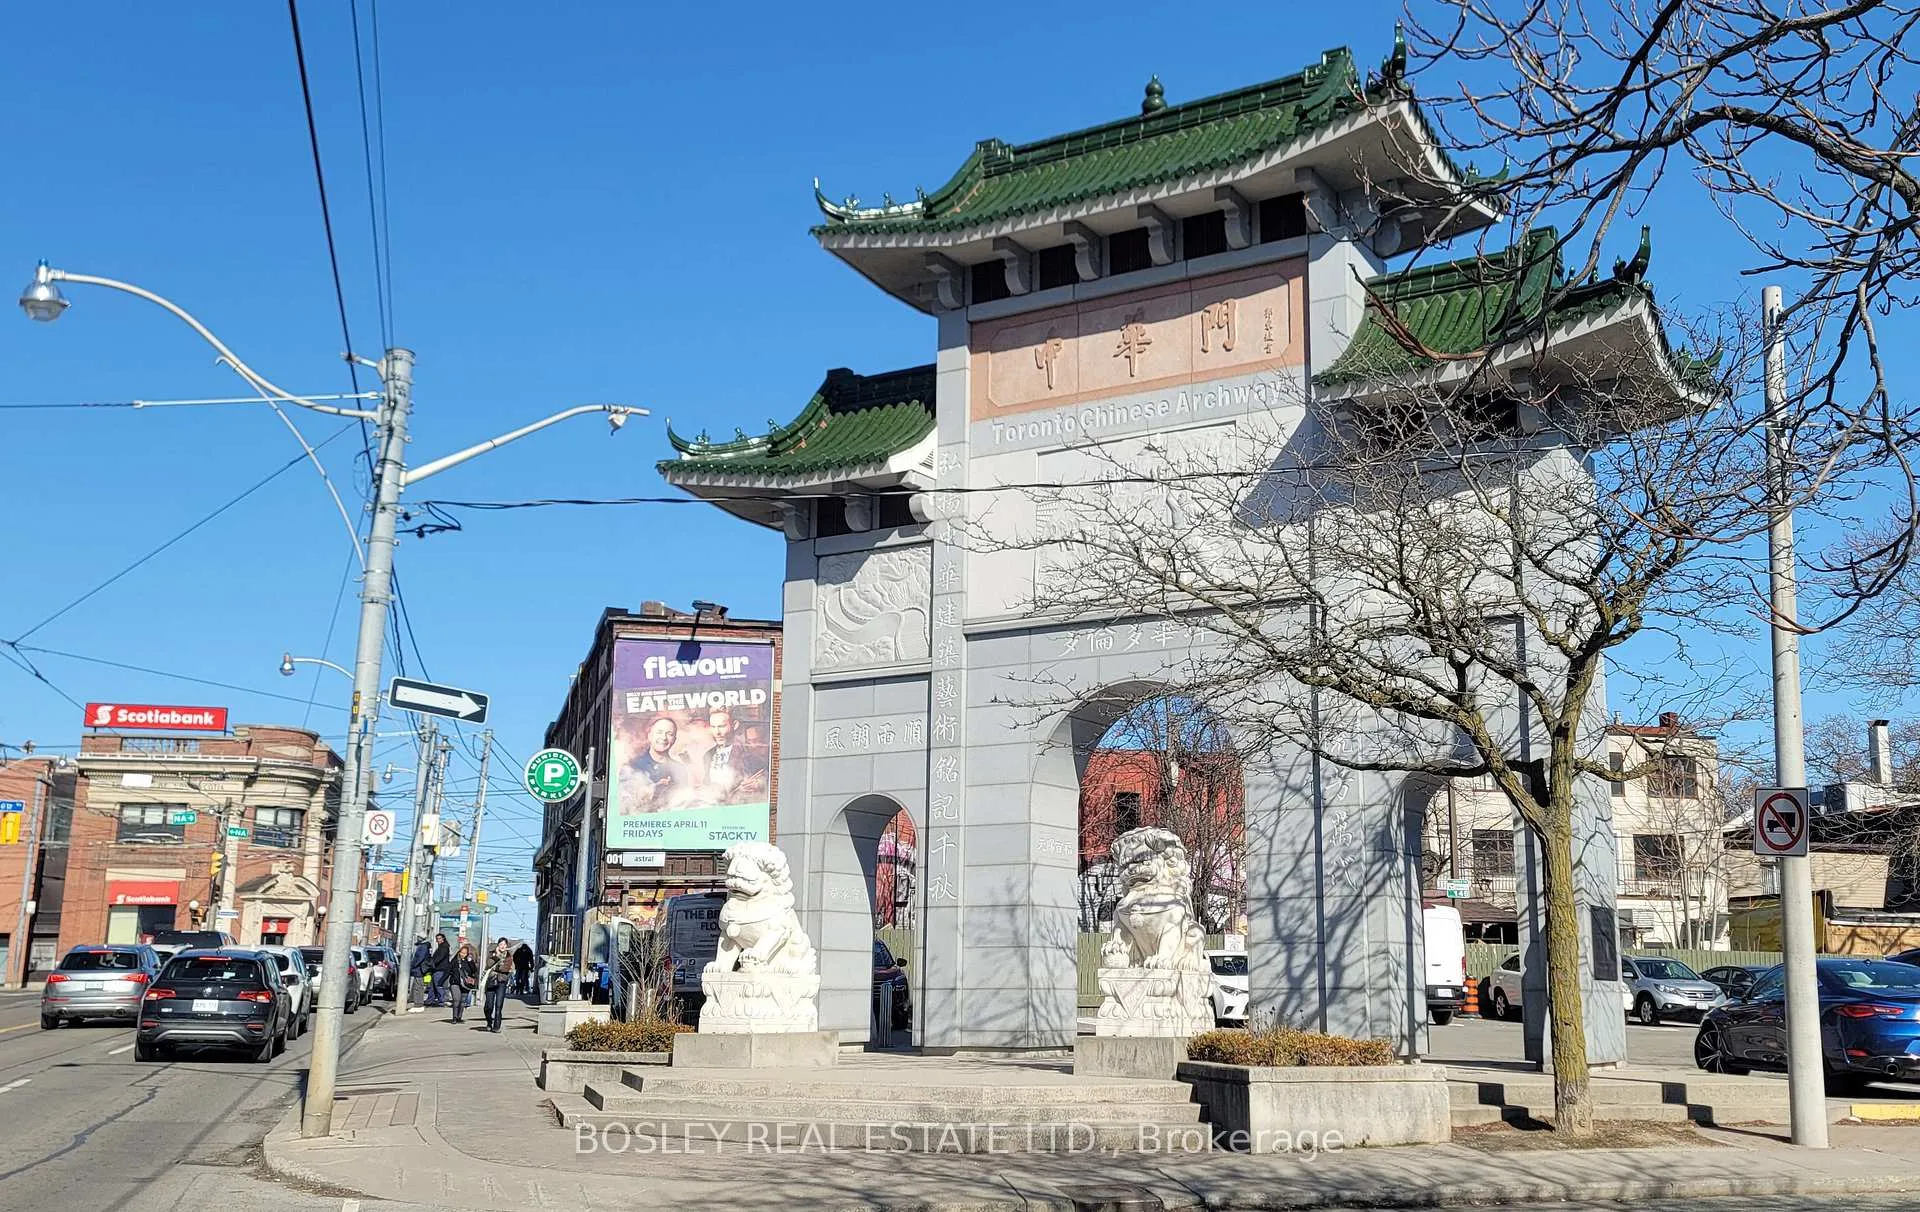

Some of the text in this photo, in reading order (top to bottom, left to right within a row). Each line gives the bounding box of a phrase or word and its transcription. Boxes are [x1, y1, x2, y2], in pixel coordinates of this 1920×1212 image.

[991, 379, 1287, 445] Toronto Chinese Archway
[643, 655, 749, 680] flavour
[626, 694, 667, 714] EAT
[684, 688, 767, 711] WORLD
[116, 709, 215, 726] Scotiabank
[543, 763, 565, 783] P
[623, 820, 672, 828] PREMIERES
[673, 820, 698, 828] APRIL
[623, 830, 663, 838] FRIDAYS
[606, 853, 623, 865] 001
[683, 909, 705, 920] THE
[700, 921, 720, 931] FLO
